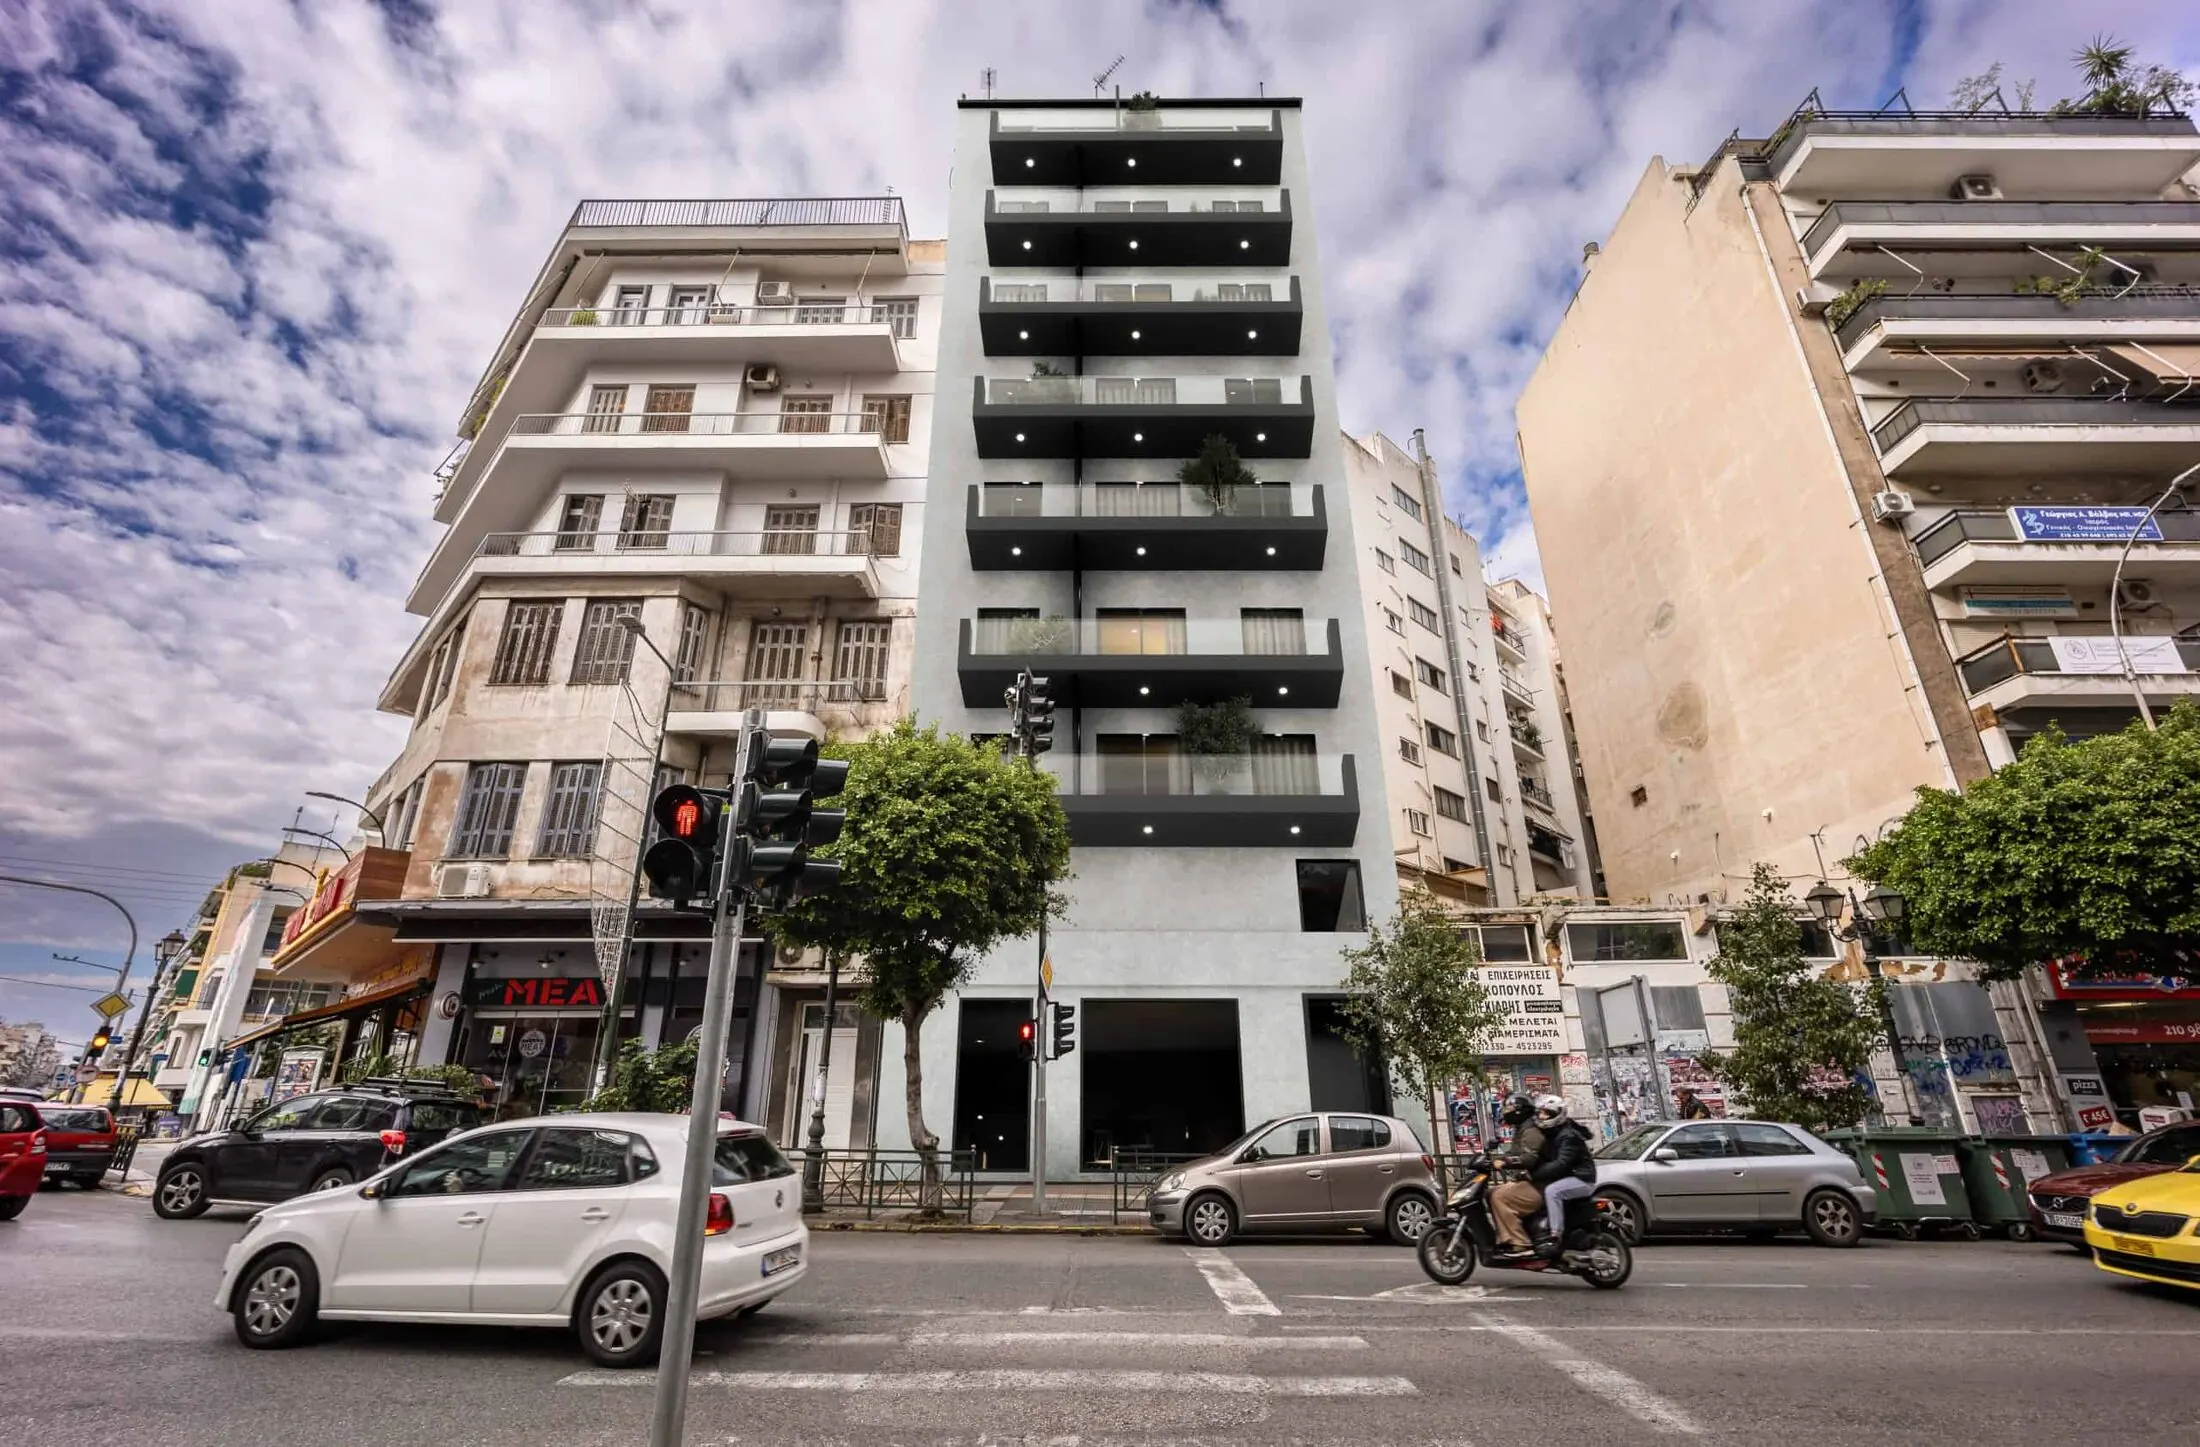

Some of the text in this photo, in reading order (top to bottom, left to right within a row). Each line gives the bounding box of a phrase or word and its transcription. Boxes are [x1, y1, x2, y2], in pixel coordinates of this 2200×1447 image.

[1488, 970, 1551, 980] ΕΠΙΧΕΙΡΗΣΕΙΣ
[503, 978, 599, 1005] MEA
[1484, 985, 1544, 996] ΚΟΠΟΥΛΟΣ
[1509, 1018, 1557, 1026] ΜΕΛΕΤΑΙ
[2163, 1025, 2185, 1036] 210
[2072, 1080, 2098, 1092] pizza
